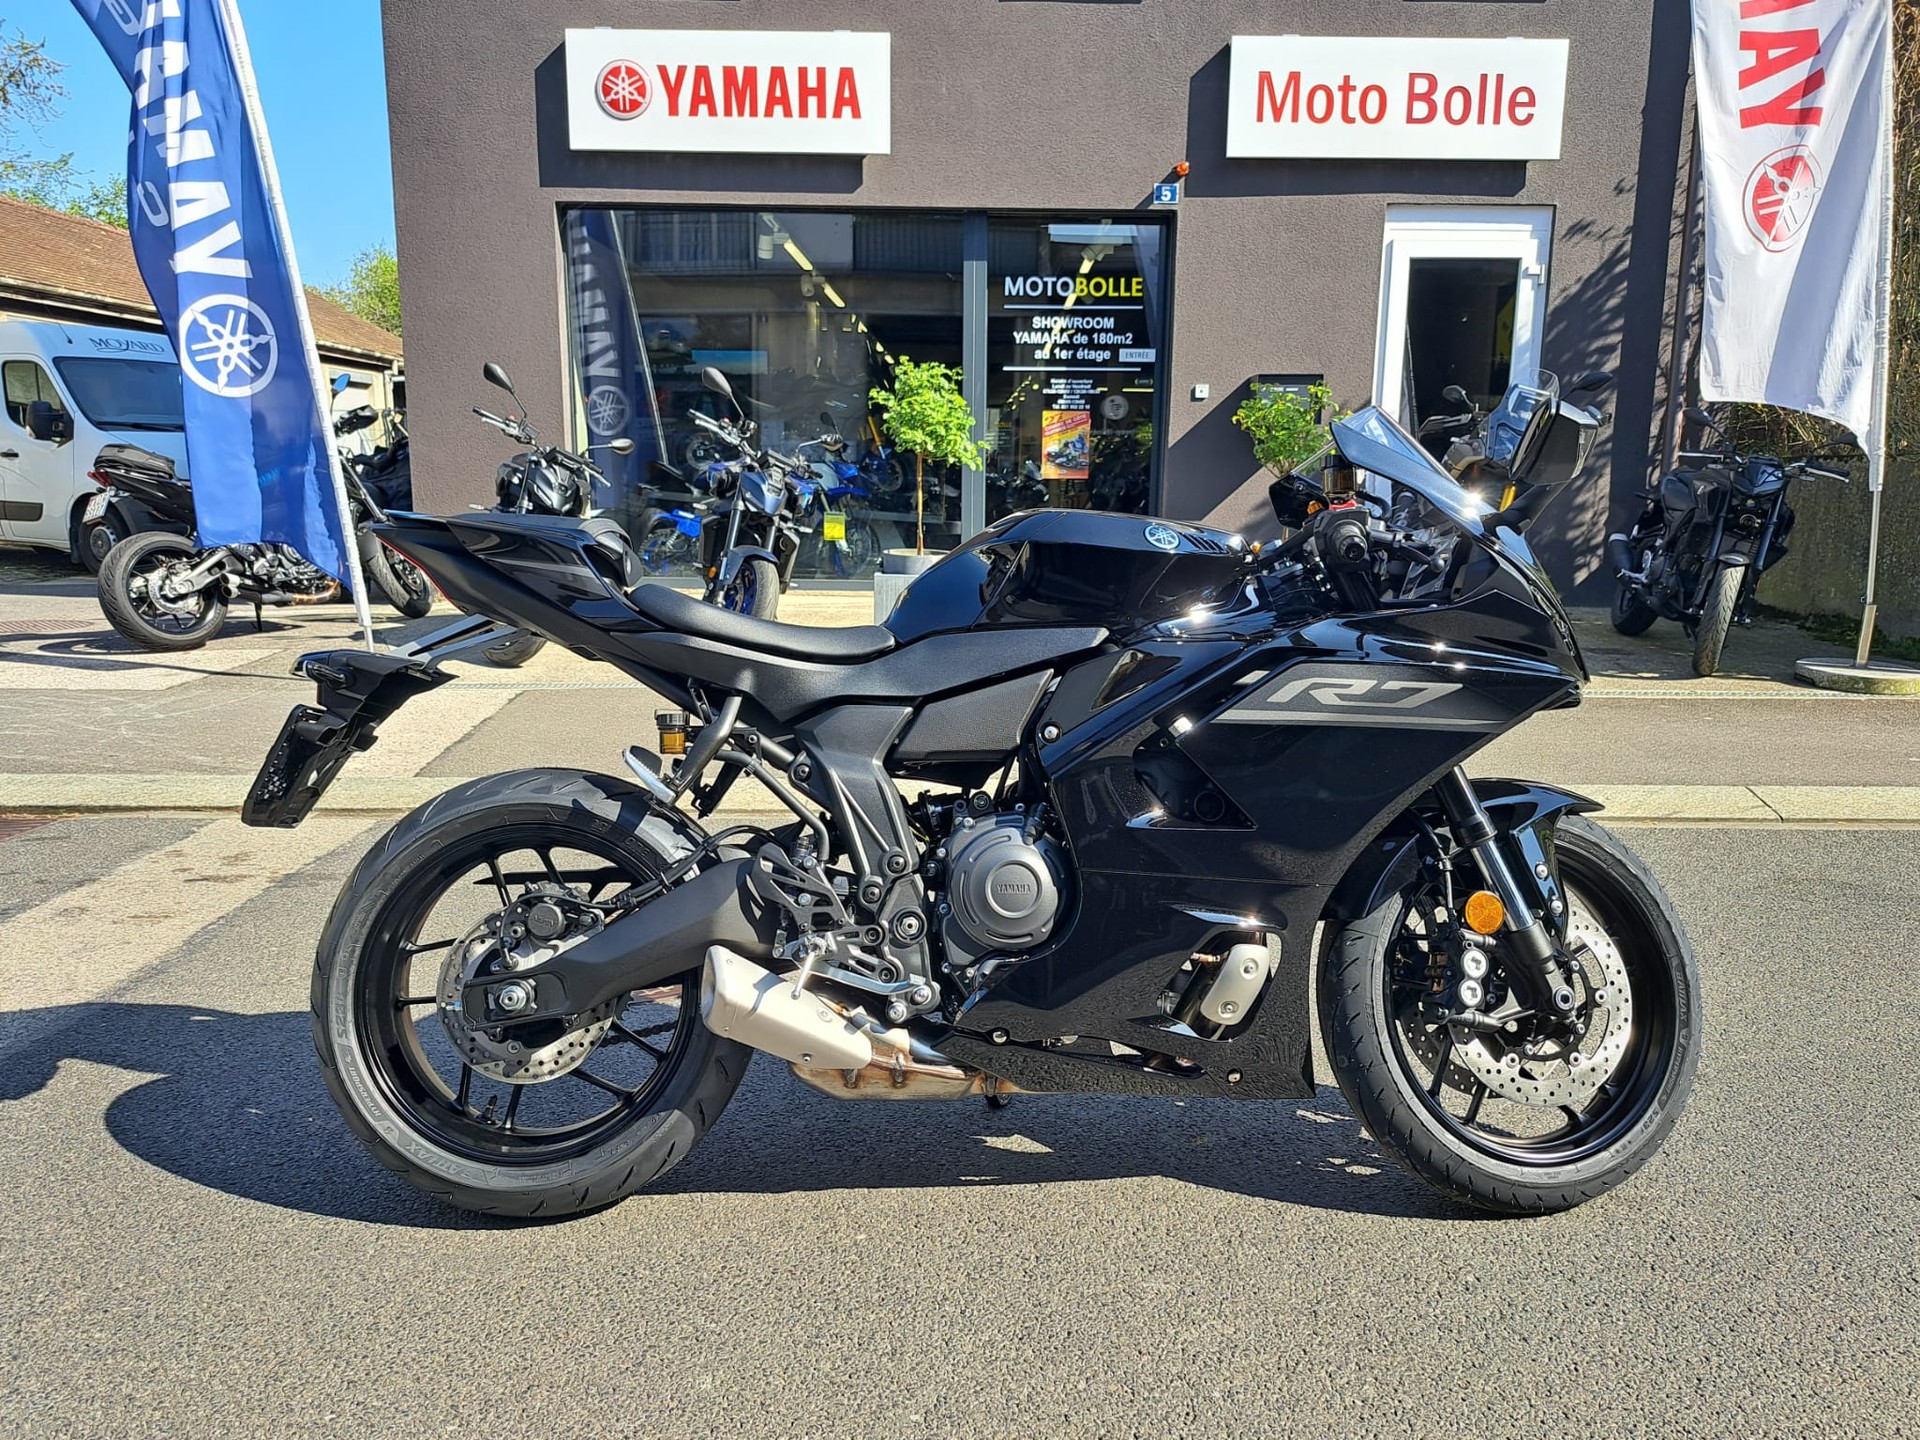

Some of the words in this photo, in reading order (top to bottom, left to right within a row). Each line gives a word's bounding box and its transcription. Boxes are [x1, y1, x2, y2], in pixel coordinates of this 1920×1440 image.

[656, 64, 862, 119] YAMAHA
[1256, 70, 1388, 125] Moto
[1405, 72, 1537, 126] Bolle
[1160, 186, 1172, 201] 5
[1032, 316, 1114, 329] SHOWROOM
[1013, 332, 1069, 344] YAMAHA
[1073, 333, 1088, 344] de
[1092, 332, 1133, 344] 180m2
[1034, 349, 1050, 359] au
[1053, 347, 1073, 359] 1er
[1076, 347, 1111, 362] étage
[1267, 677, 1463, 709] R7
[996, 883, 1031, 894] YAMAHA
[349, 1067, 382, 1116] HYPERSPORT
